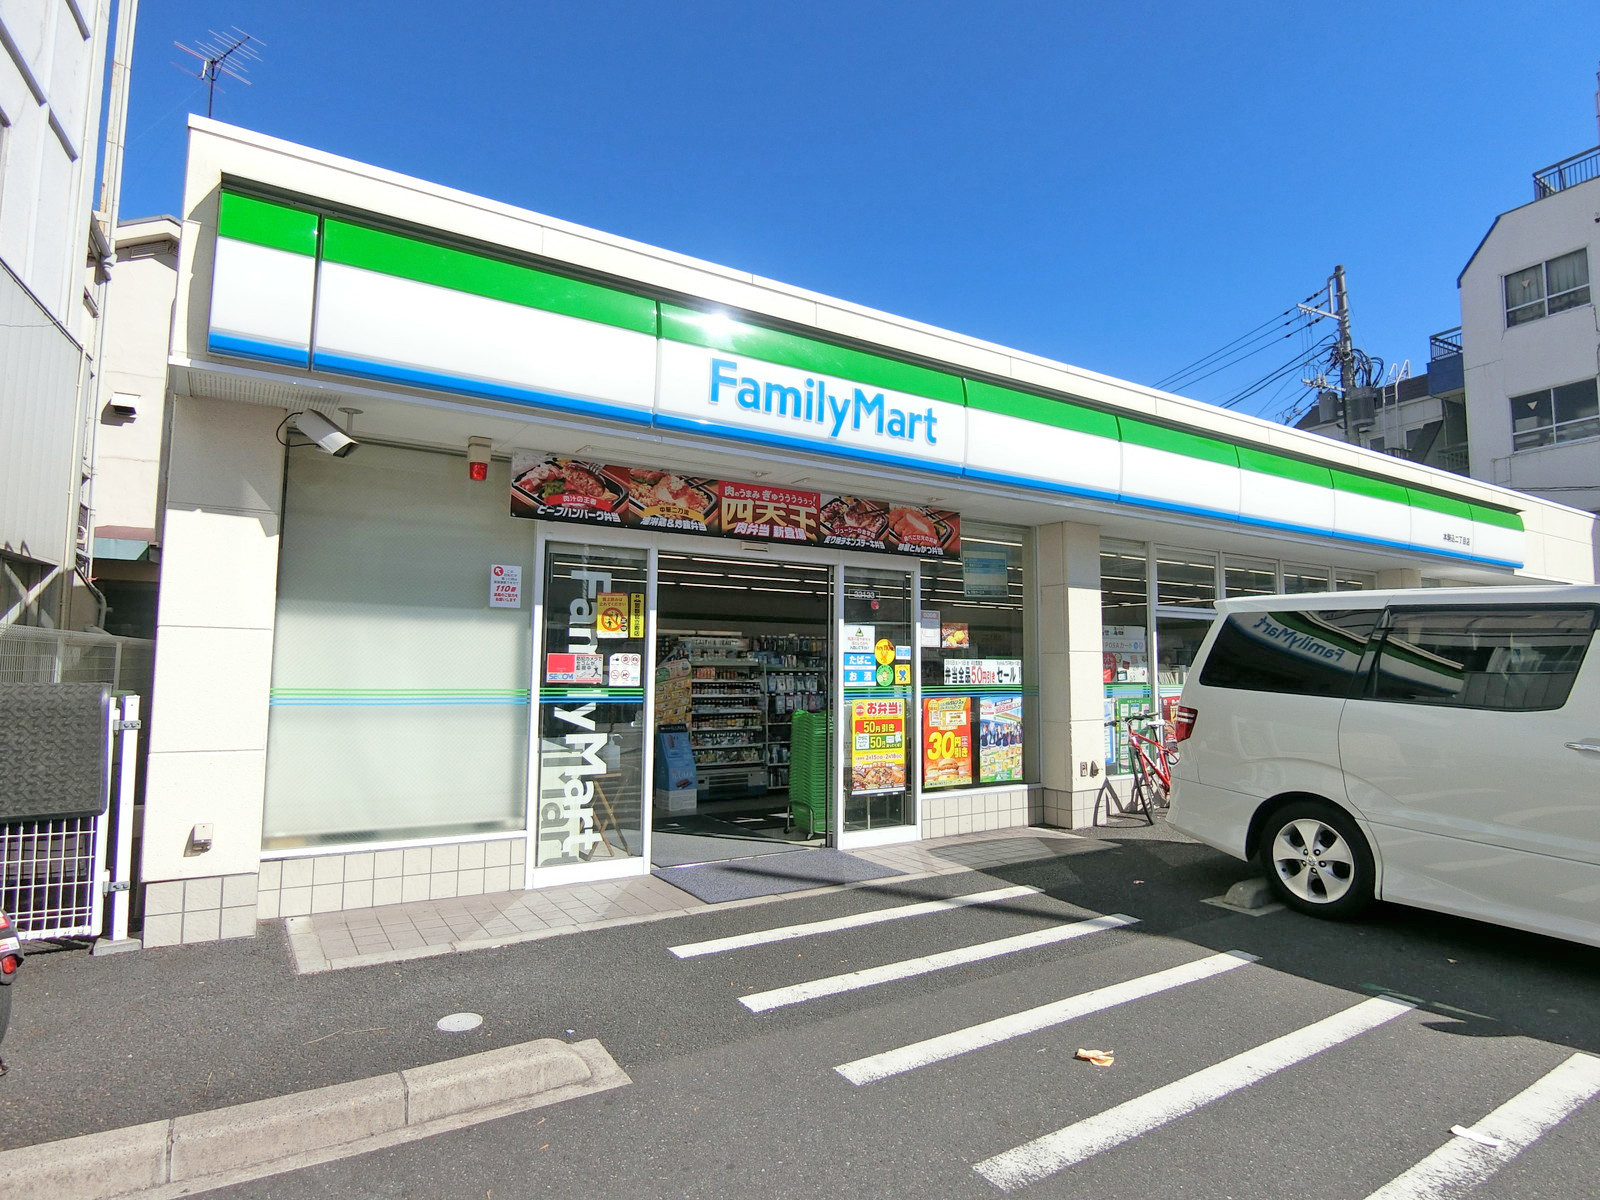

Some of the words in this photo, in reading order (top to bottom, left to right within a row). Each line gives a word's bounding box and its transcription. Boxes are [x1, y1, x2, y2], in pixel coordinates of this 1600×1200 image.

[709, 358, 938, 445] FamilyMart
[537, 504, 622, 523] ビーフハンバーグ弁当
[721, 496, 818, 541] 四天王
[733, 521, 770, 537] 肉弁当
[772, 525, 807, 541] 新登場
[849, 655, 872, 665] たばこ
[866, 701, 898, 715] お弁当
